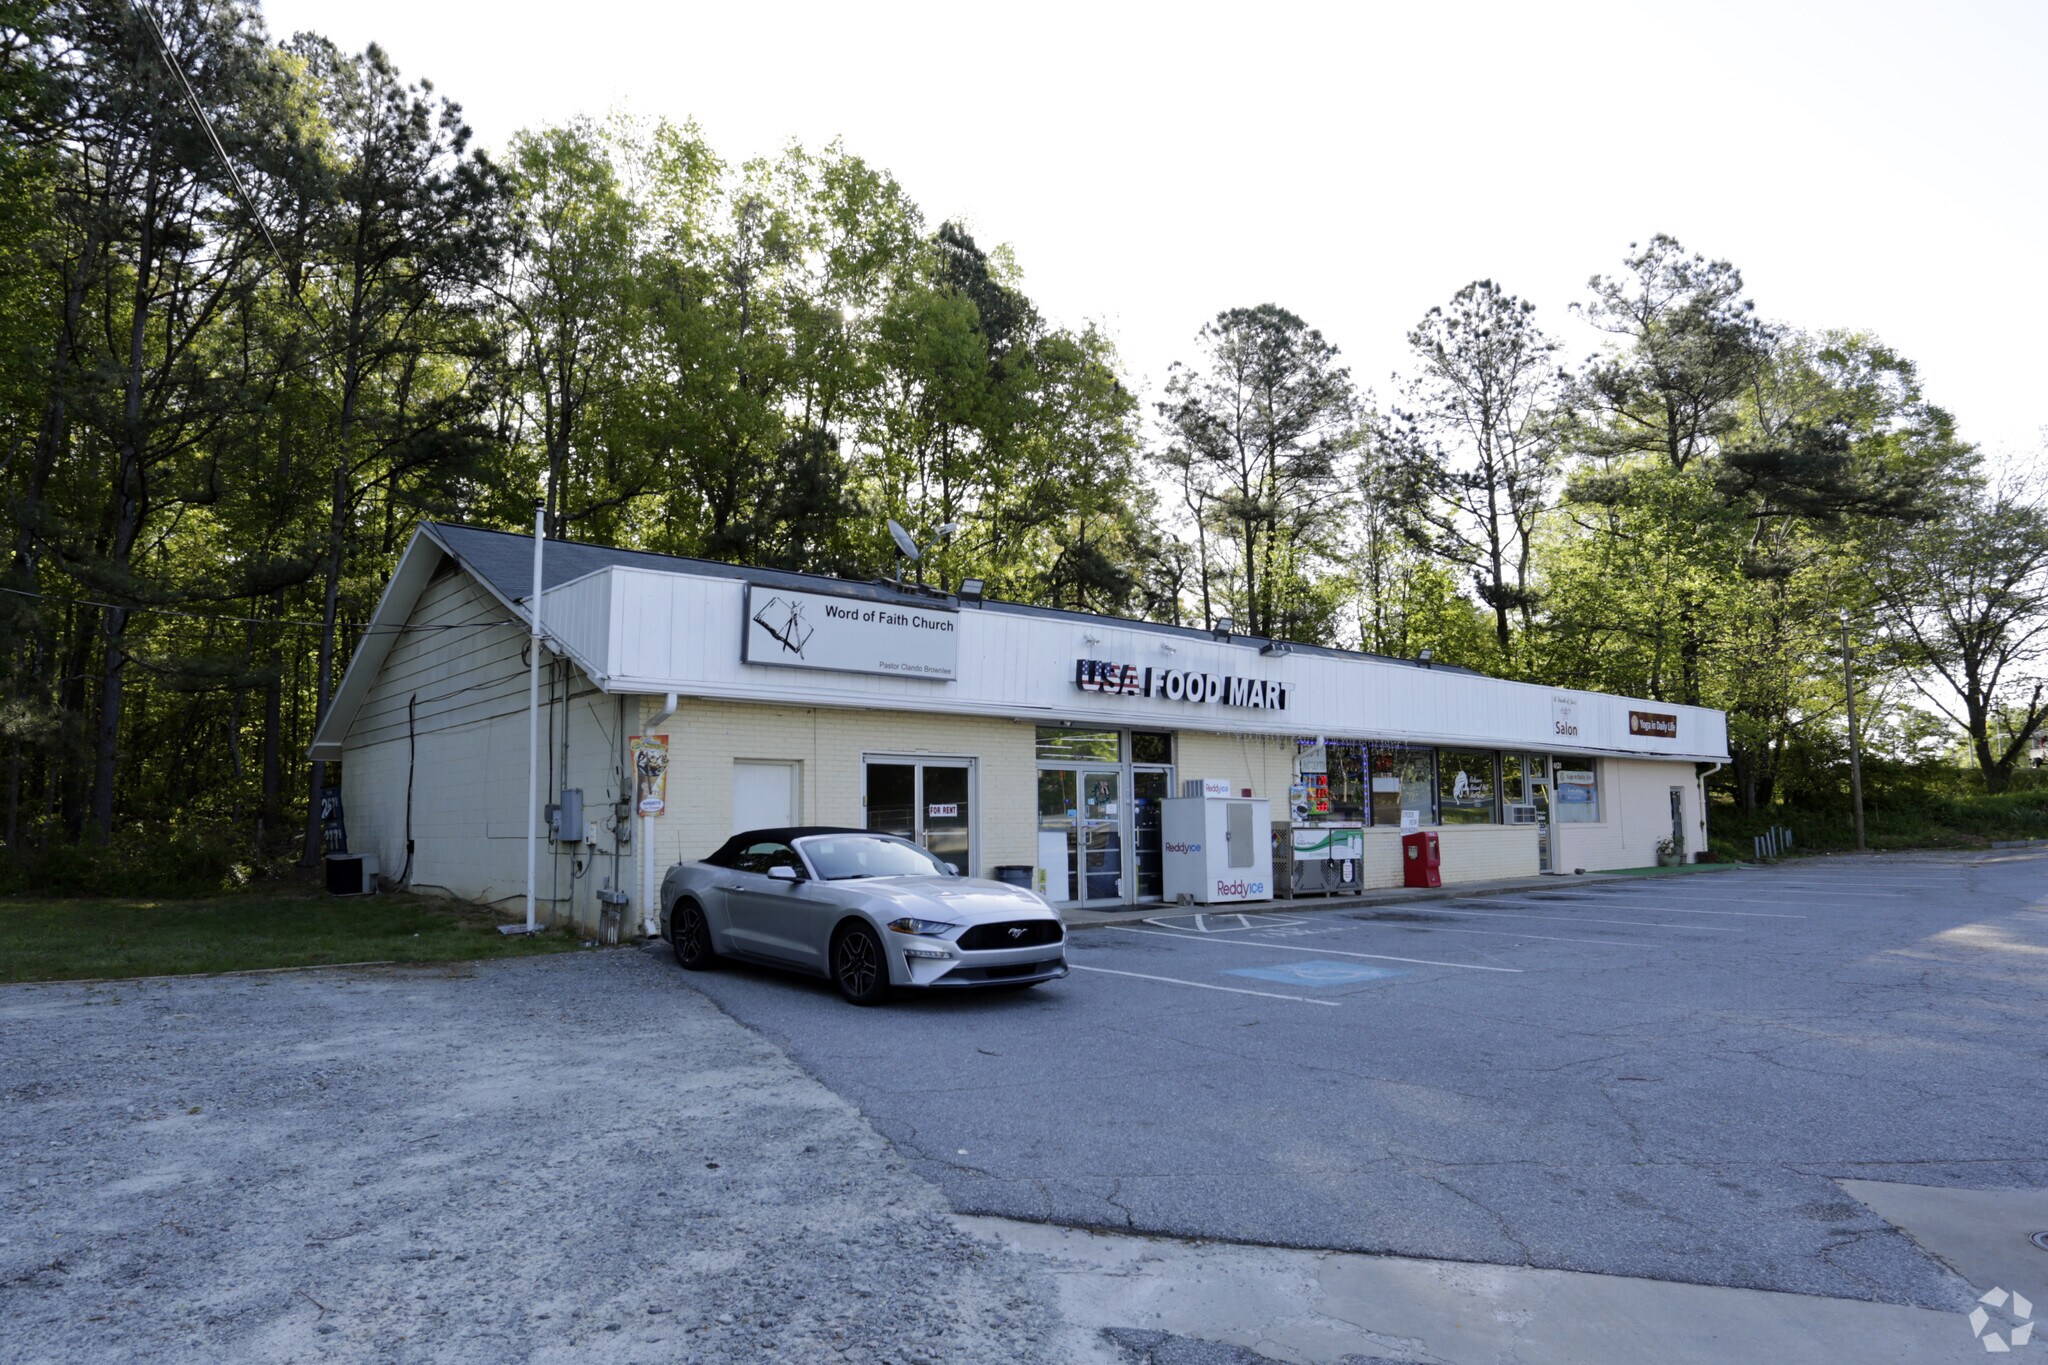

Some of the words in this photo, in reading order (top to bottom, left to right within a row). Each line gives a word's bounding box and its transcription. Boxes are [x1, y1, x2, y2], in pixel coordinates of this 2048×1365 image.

[825, 604, 859, 620] Word
[863, 610, 875, 623] of
[879, 611, 908, 627] Faith
[912, 616, 954, 631] Church
[879, 661, 900, 670] Pastor
[924, 665, 952, 675] Brownlee
[1077, 659, 1141, 697] USA
[1145, 667, 1222, 703] FOOD
[1224, 676, 1295, 710] MART
[1555, 721, 1578, 736] Salon
[1640, 719, 1651, 731] Yoga
[1652, 720, 1656, 730] in
[1657, 720, 1667, 733] Daily
[1668, 721, 1676, 732] Life
[930, 806, 941, 815] FOR
[942, 806, 956, 815] RENT
